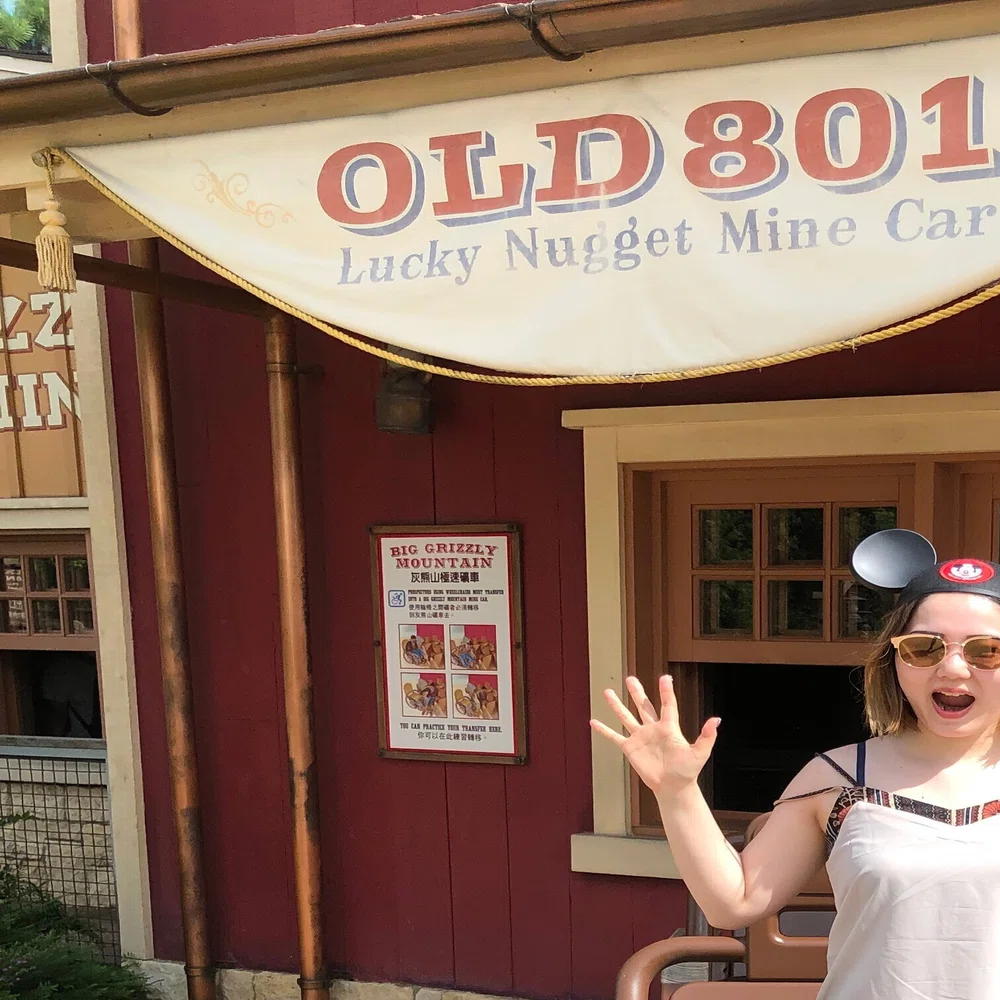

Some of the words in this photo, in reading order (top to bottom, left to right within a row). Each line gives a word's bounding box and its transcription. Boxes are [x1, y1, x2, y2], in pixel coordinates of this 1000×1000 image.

[317, 113, 665, 236] OLD
[337, 240, 482, 286] Lucky
[505, 216, 693, 275] Nugget
[717, 207, 857, 254] Mine
[885, 198, 997, 243] Car
[390, 545, 418, 557] BIG
[425, 543, 498, 556] GRIZZLY
[396, 558, 493, 568] MOUNTAIN
